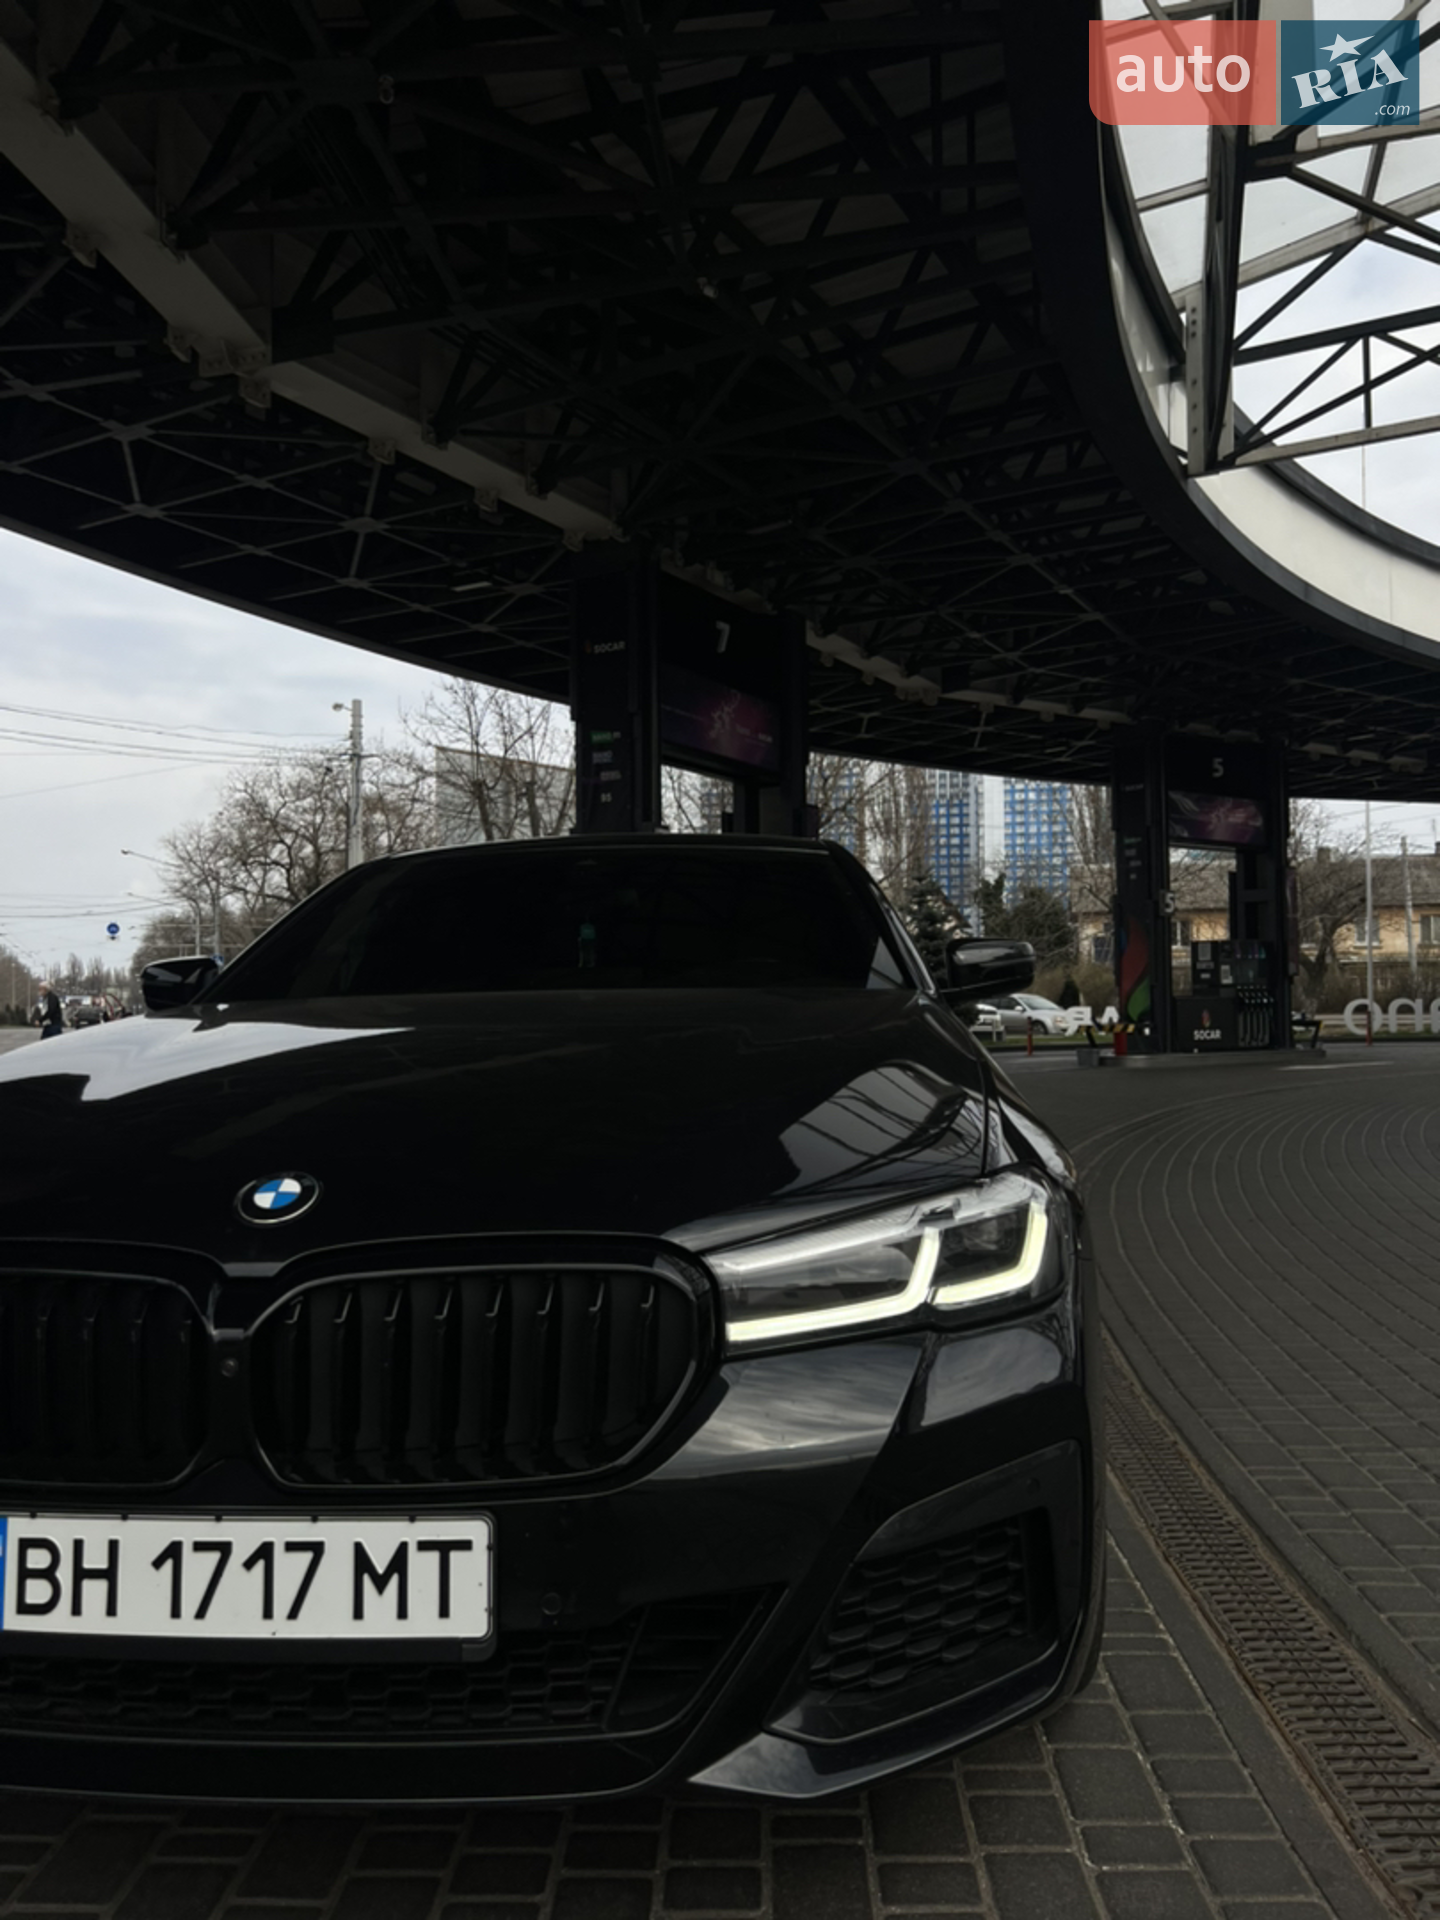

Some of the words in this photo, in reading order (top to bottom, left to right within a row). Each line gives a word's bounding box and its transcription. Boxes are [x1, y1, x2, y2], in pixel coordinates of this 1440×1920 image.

[715, 619, 731, 654] 7
[1210, 756, 1225, 778] 5
[1164, 892, 1175, 913] 5
[1192, 1028, 1222, 1041] SOCAR
[15, 1537, 119, 1617] BH
[151, 1539, 325, 1620] 1717
[352, 1539, 473, 1620] MT
